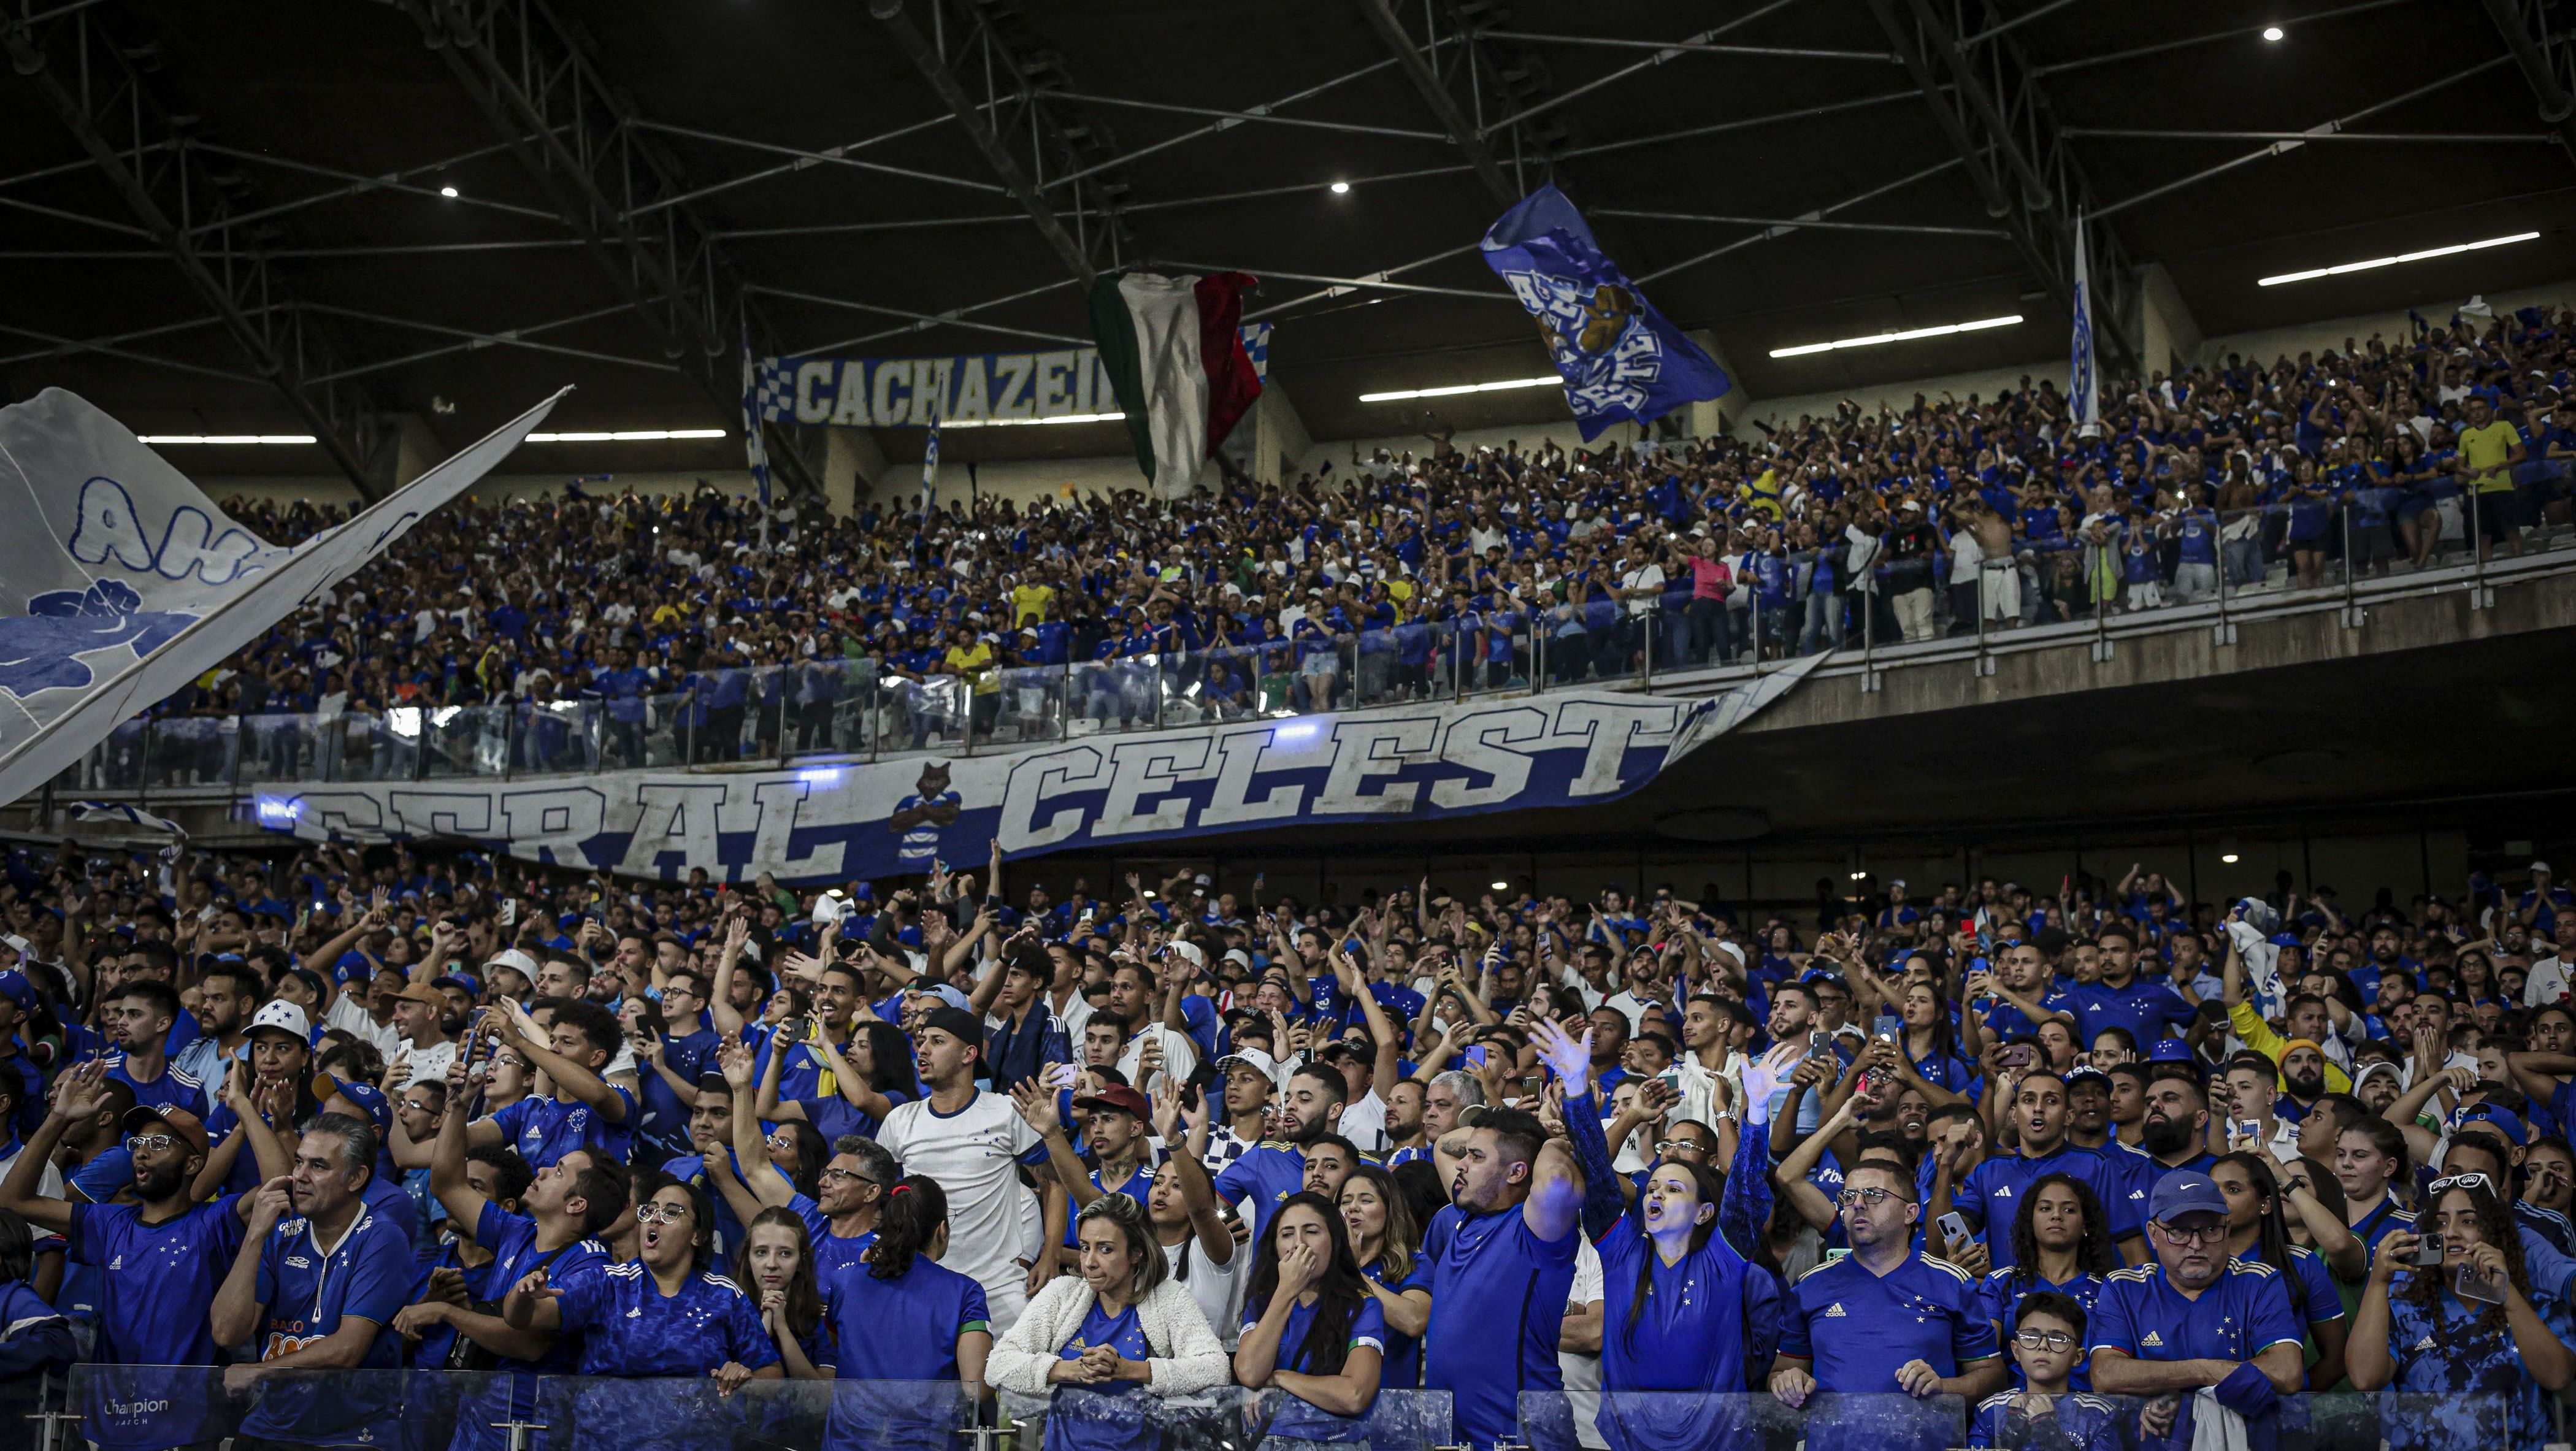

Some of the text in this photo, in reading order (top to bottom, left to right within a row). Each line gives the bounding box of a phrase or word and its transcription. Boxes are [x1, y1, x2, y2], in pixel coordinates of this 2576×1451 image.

[997, 699, 1696, 852] CELEST
[2461, 1175, 2478, 1184] LOSO
[284, 1224, 305, 1238] MIX
[2415, 1342, 2437, 1351] adidas
[104, 1398, 169, 1418] Champion
